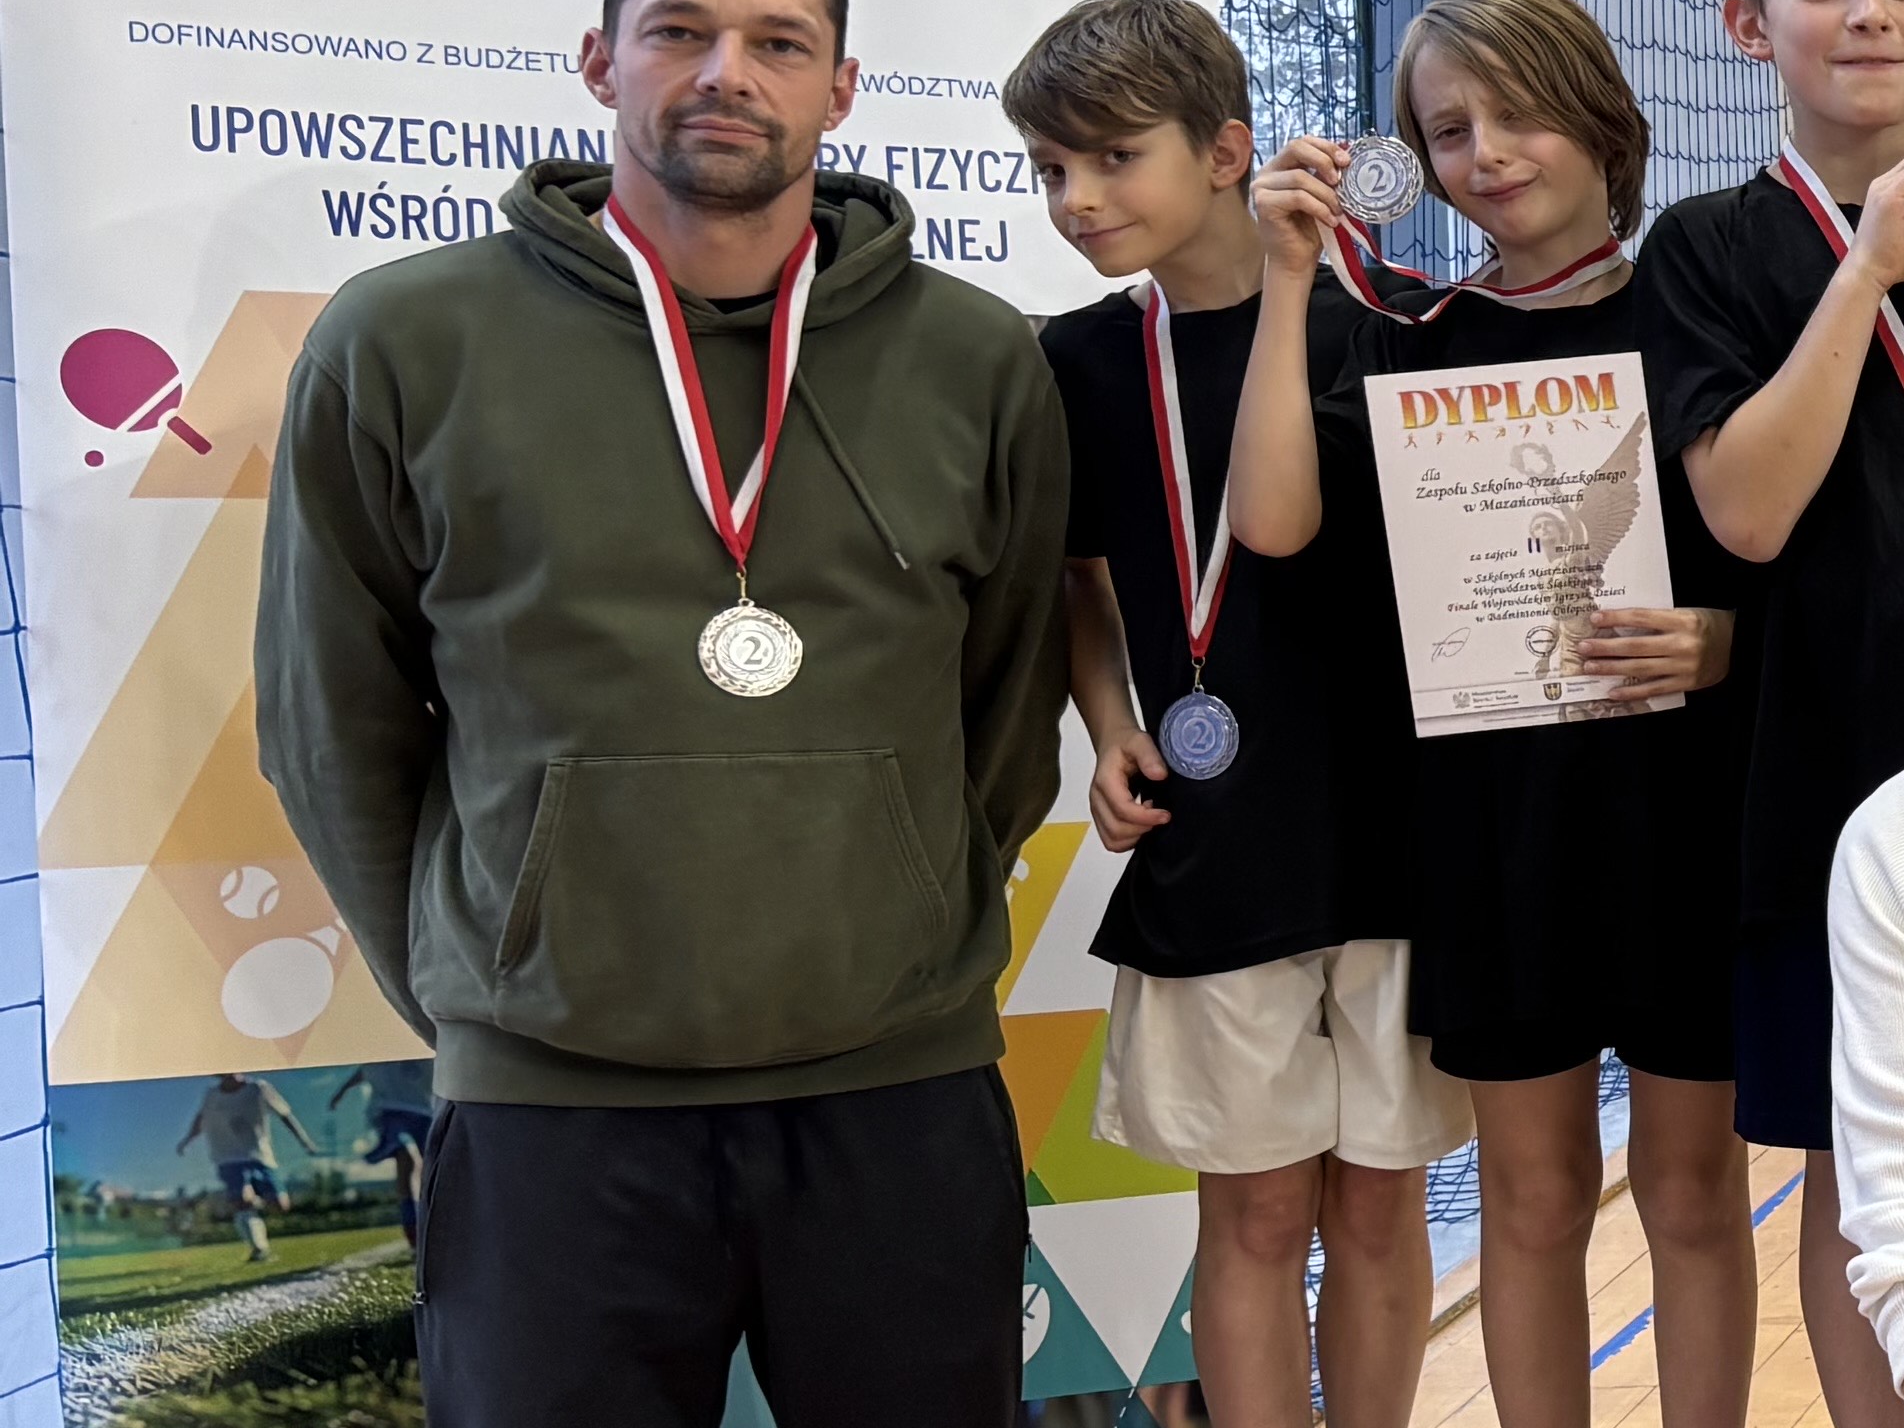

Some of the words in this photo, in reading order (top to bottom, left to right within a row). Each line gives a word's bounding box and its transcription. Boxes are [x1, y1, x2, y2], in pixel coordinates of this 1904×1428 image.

[128, 20, 407, 62] DOFINANSOWANO
[416, 41, 436, 65] Z
[443, 44, 583, 74] BUDŻETU
[1367, 163, 1388, 193] 2
[322, 181, 493, 242] WŚRÓD
[1397, 372, 1620, 430] DYPLOM
[1421, 468, 1441, 483] dla
[1416, 483, 1468, 501] Zespołu
[1463, 503, 1477, 513] w
[1527, 537, 1541, 554] II
[742, 635, 764, 665] 2
[1190, 720, 1207, 750] 2
